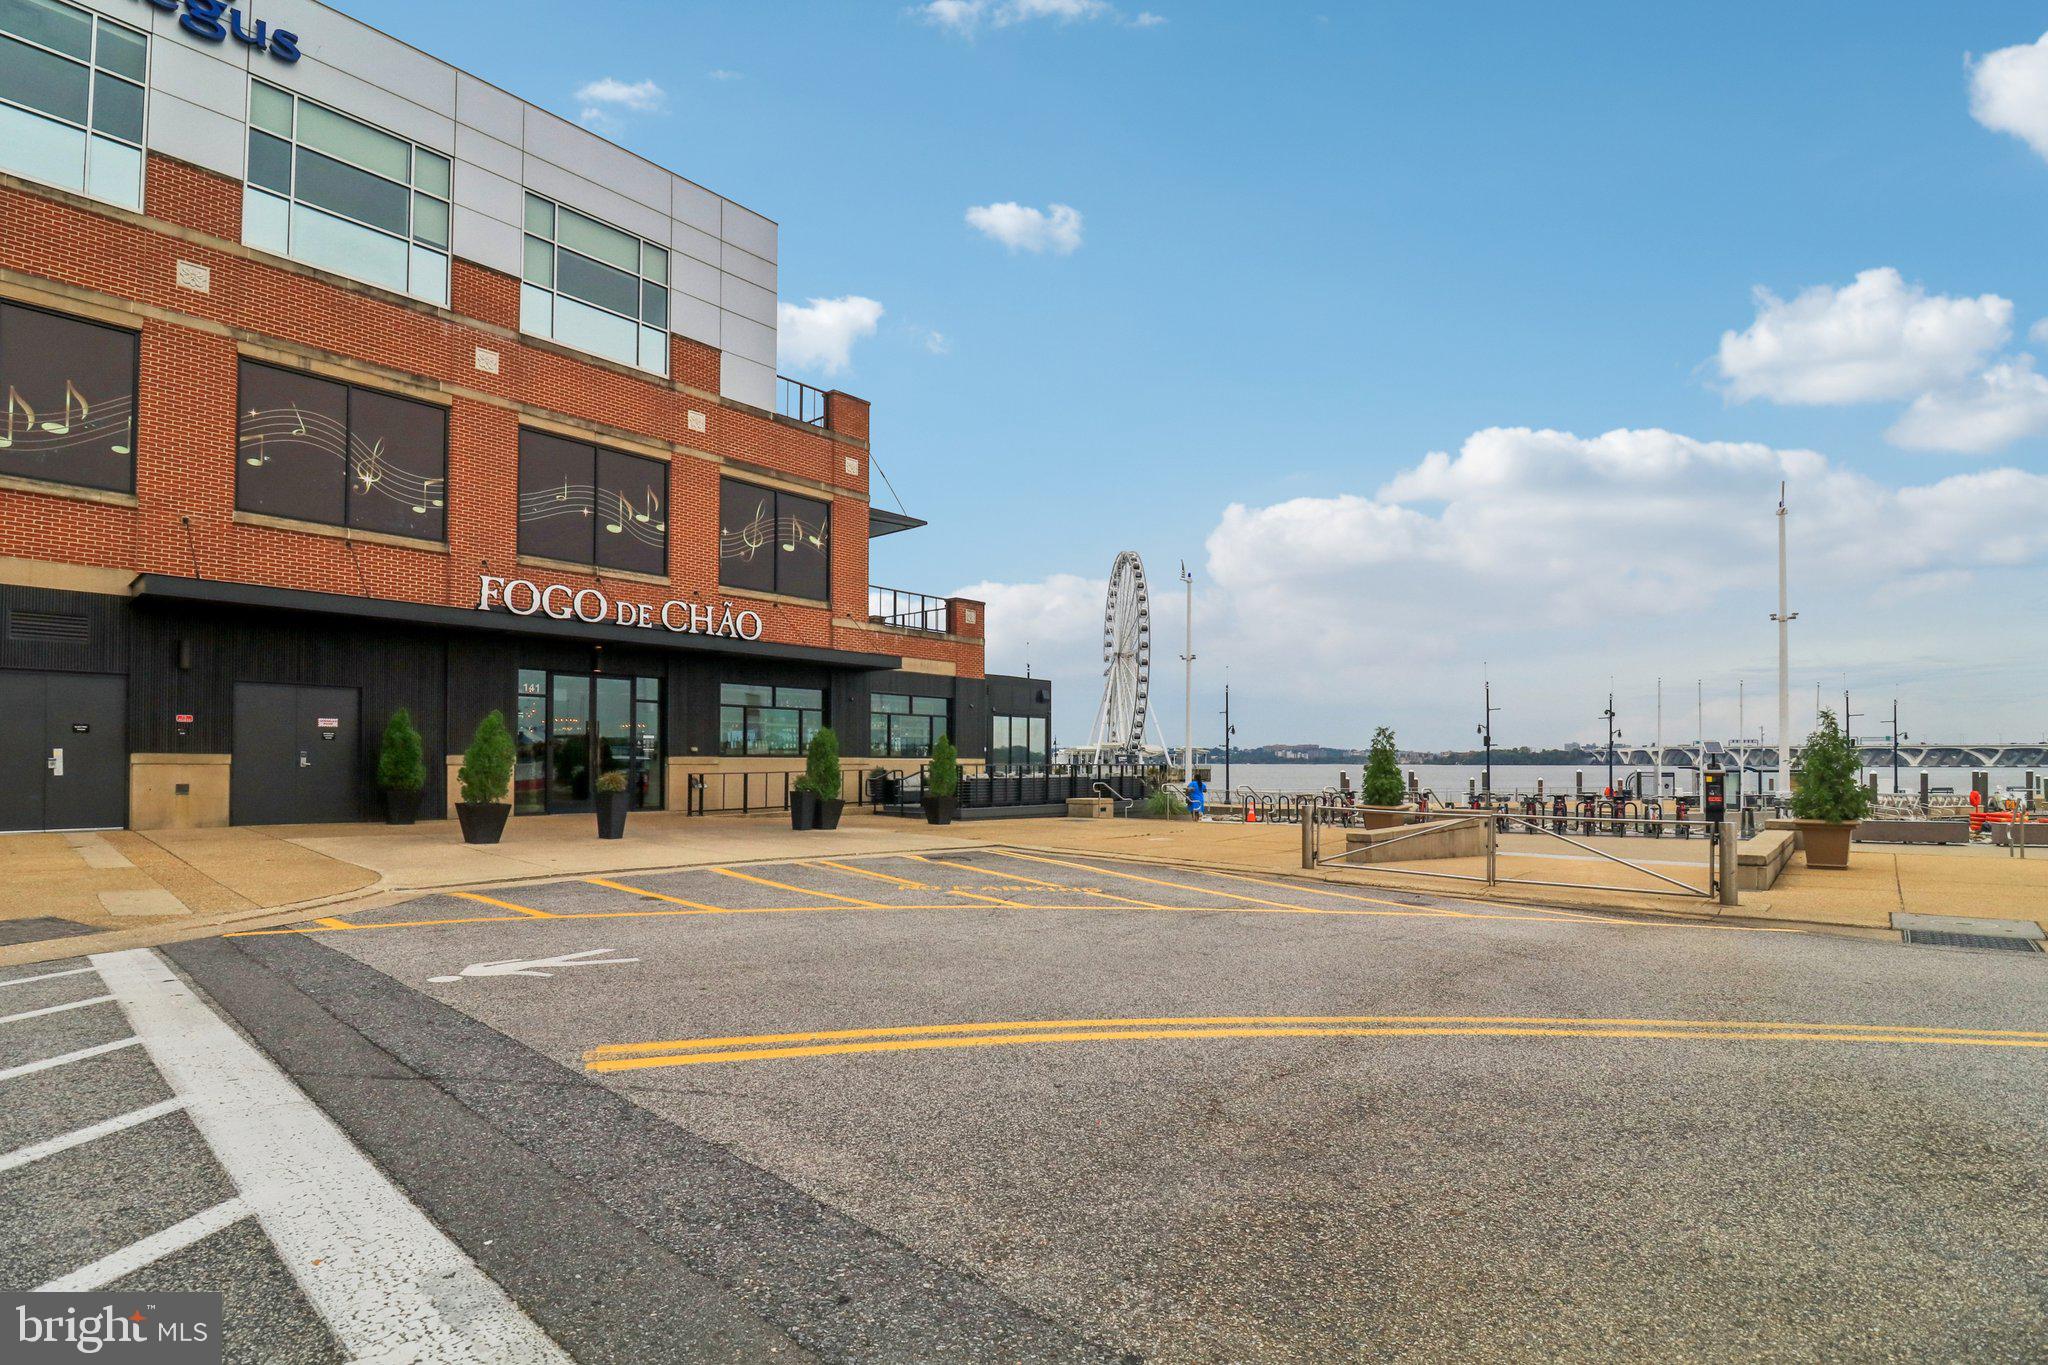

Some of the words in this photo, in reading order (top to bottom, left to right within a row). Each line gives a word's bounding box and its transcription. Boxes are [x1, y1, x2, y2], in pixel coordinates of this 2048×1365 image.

[145, 0, 301, 64] gus
[477, 575, 608, 623] FOGO
[615, 600, 653, 628] DE
[661, 600, 763, 640] CHÃO
[523, 683, 540, 693] 141
